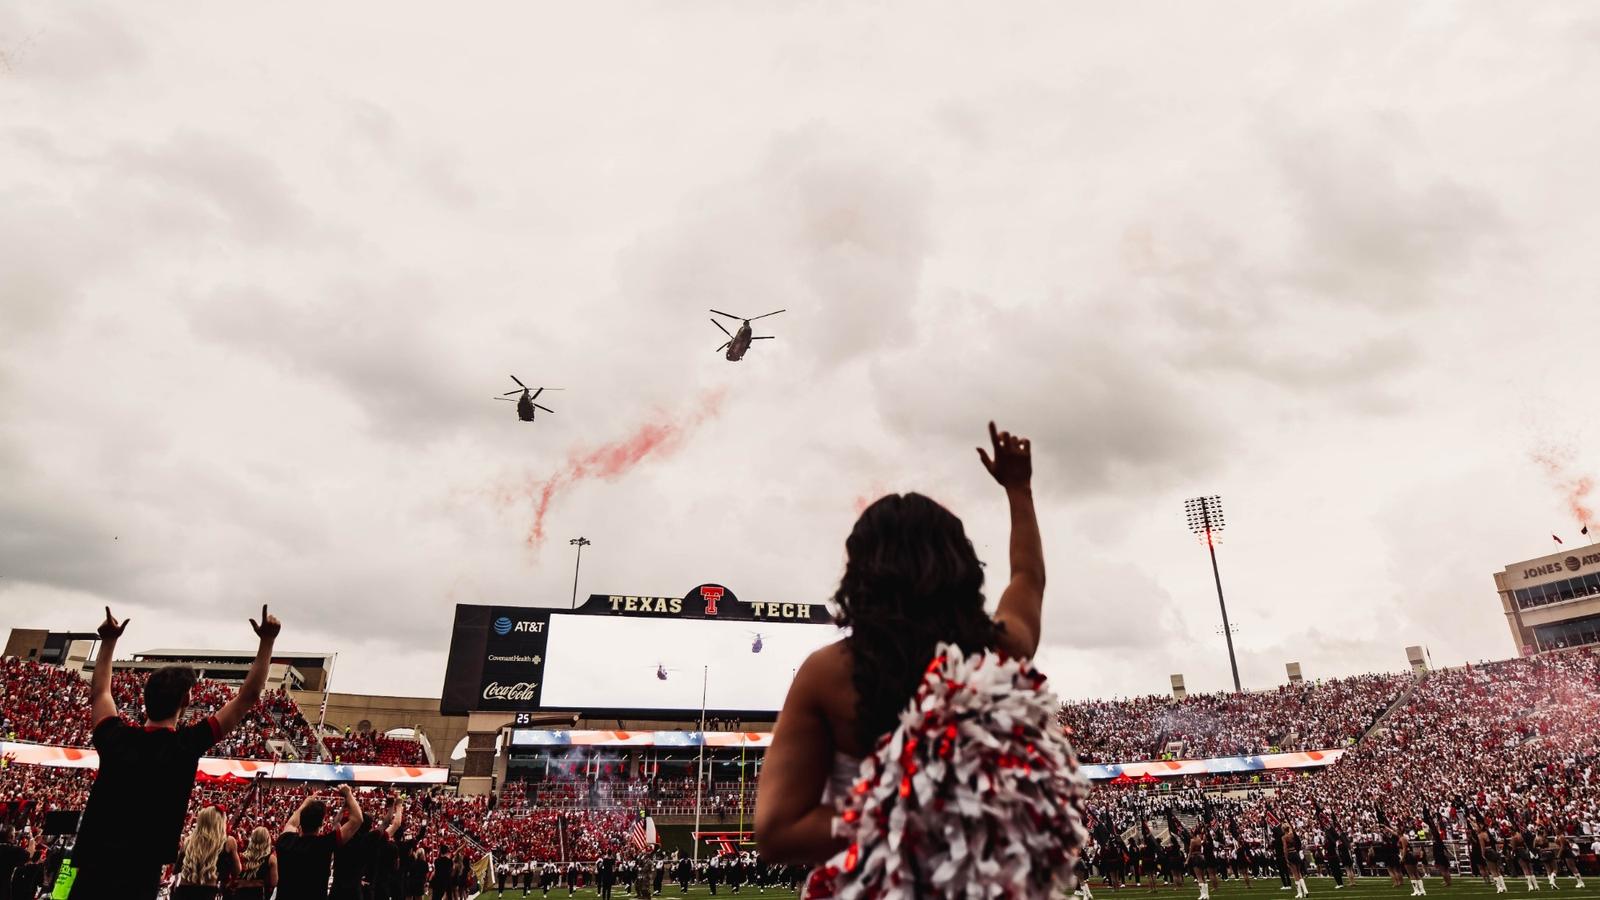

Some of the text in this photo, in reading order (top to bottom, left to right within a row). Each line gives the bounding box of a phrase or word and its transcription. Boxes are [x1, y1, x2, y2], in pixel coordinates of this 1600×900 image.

[1523, 552, 1600, 580] JONES AT&
[609, 595, 811, 619] TEXAS TECH
[514, 621, 545, 633] AT&T
[517, 713, 529, 724] 25
